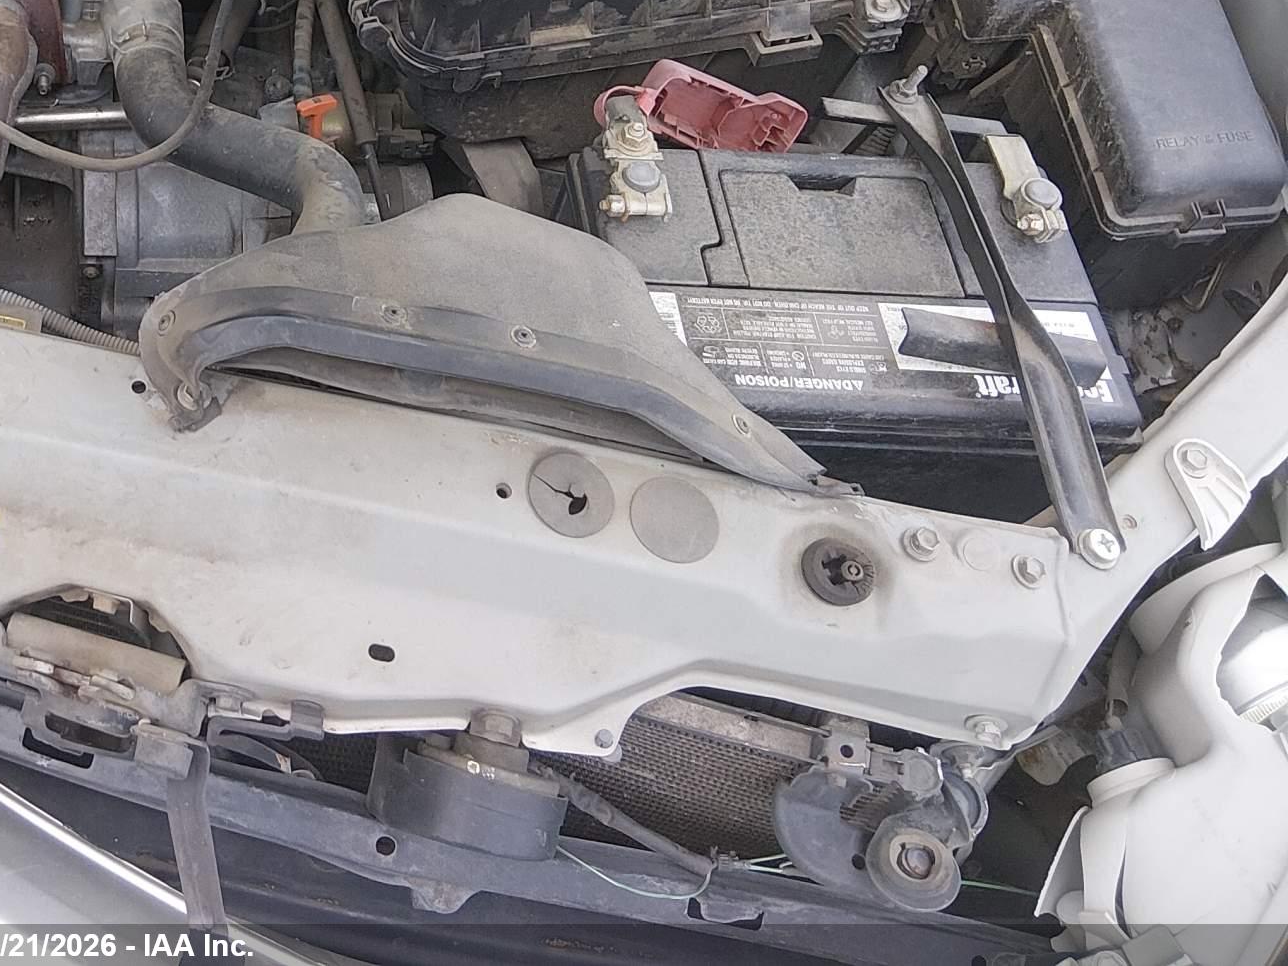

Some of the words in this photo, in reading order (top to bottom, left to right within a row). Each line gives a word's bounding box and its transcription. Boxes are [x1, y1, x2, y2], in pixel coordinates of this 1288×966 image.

[1156, 135, 1199, 149] RELAY
[1217, 130, 1253, 143] FUSE
[734, 374, 855, 390] DANGER/POISON
